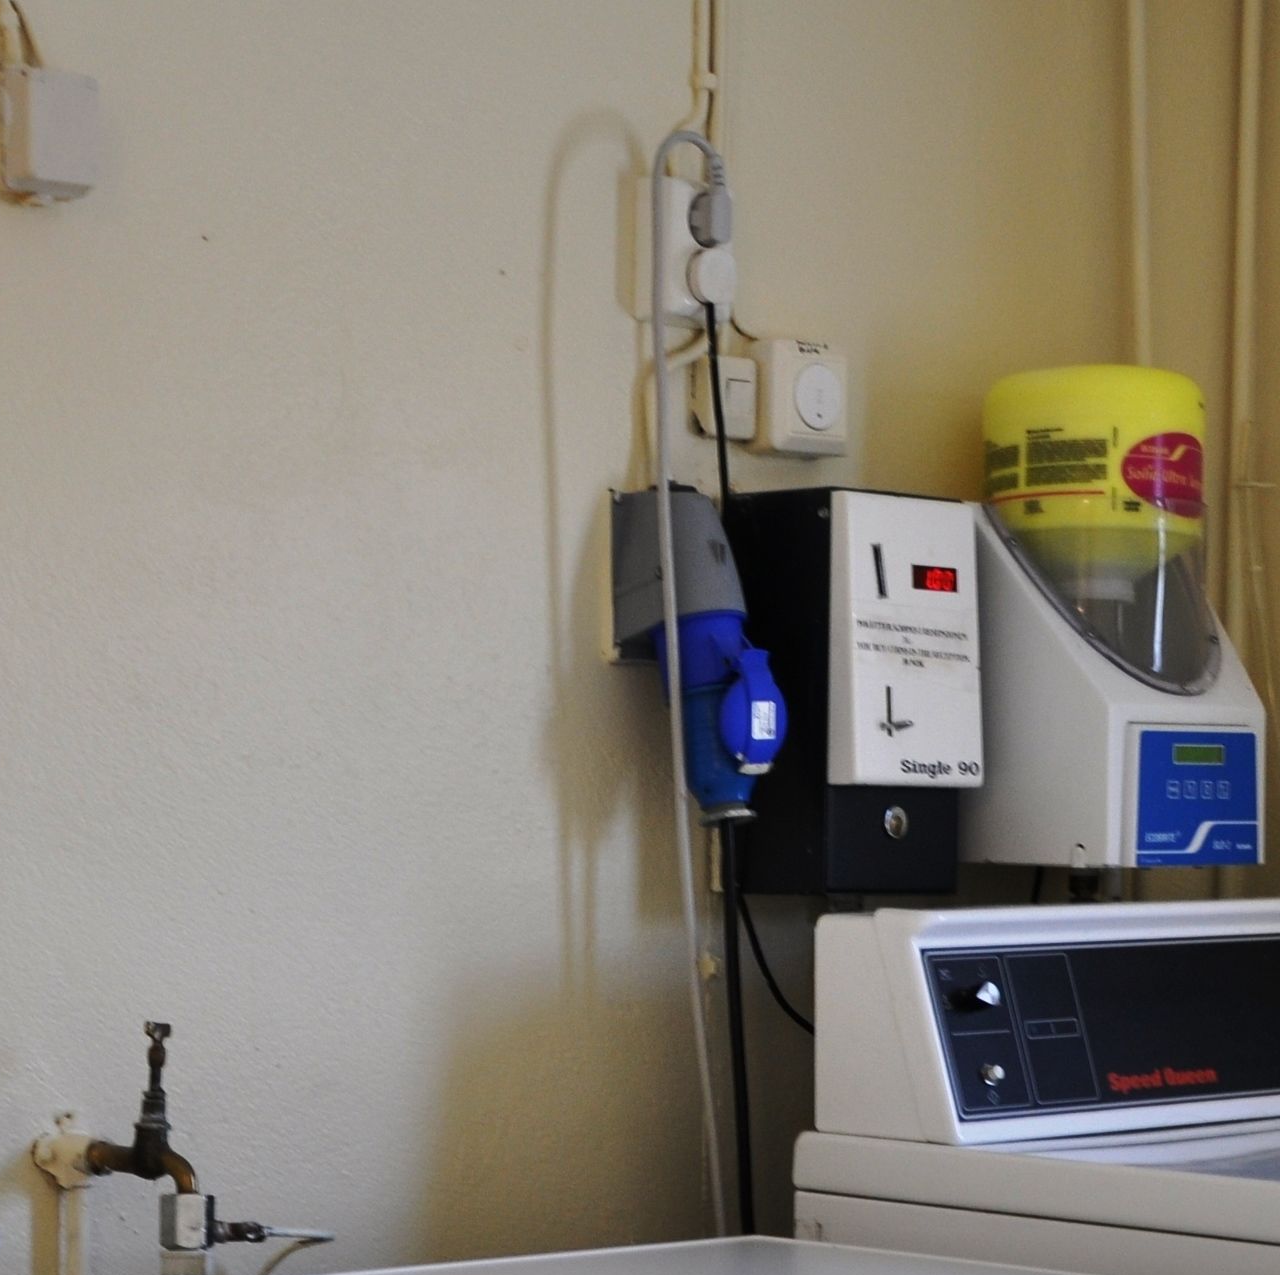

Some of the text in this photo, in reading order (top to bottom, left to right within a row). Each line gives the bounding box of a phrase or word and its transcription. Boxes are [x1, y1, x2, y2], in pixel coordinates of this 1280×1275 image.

[900, 758, 980, 779] Single 90
[1108, 1066, 1217, 1093] Speed Queen
